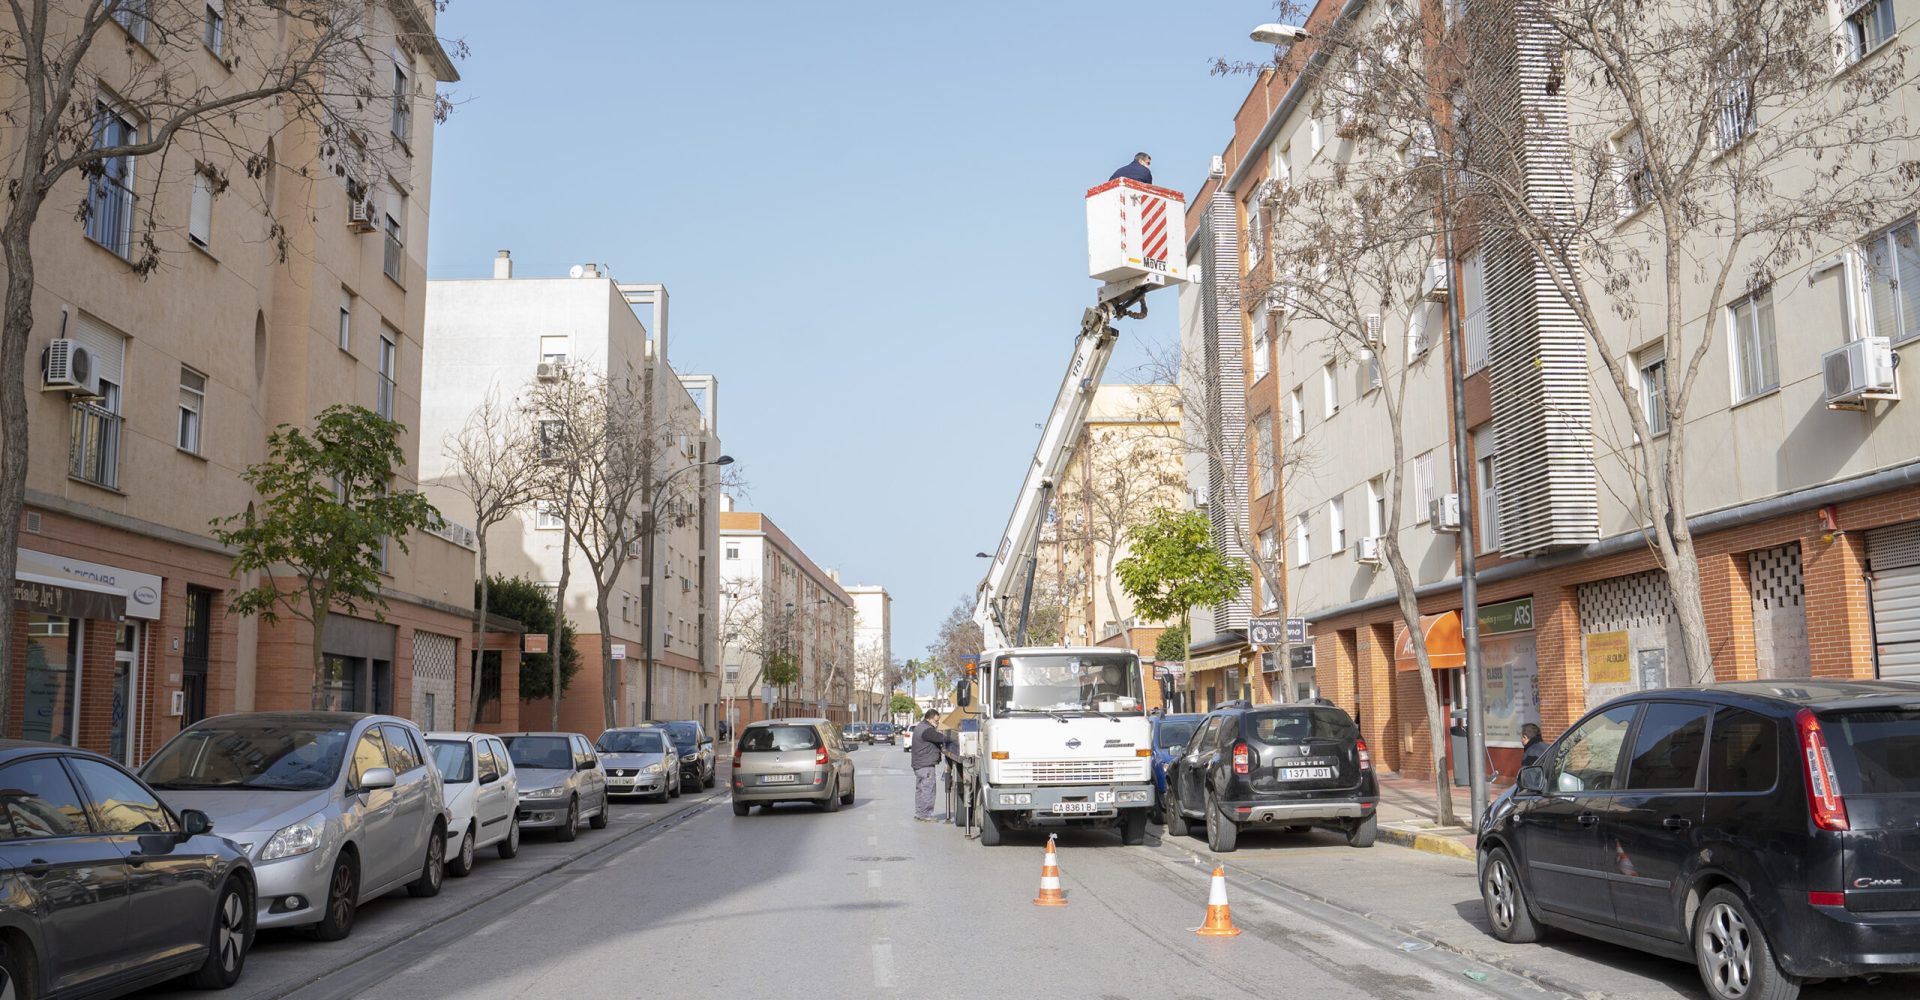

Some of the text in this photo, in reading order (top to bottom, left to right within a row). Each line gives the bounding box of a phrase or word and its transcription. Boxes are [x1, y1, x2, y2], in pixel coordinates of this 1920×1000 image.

[1143, 257, 1167, 271] MOVEX
[30, 583, 39, 602] de
[39, 585, 54, 607] Ari
[1513, 605, 1531, 626] ARS
[1289, 769, 1310, 778] 1371
